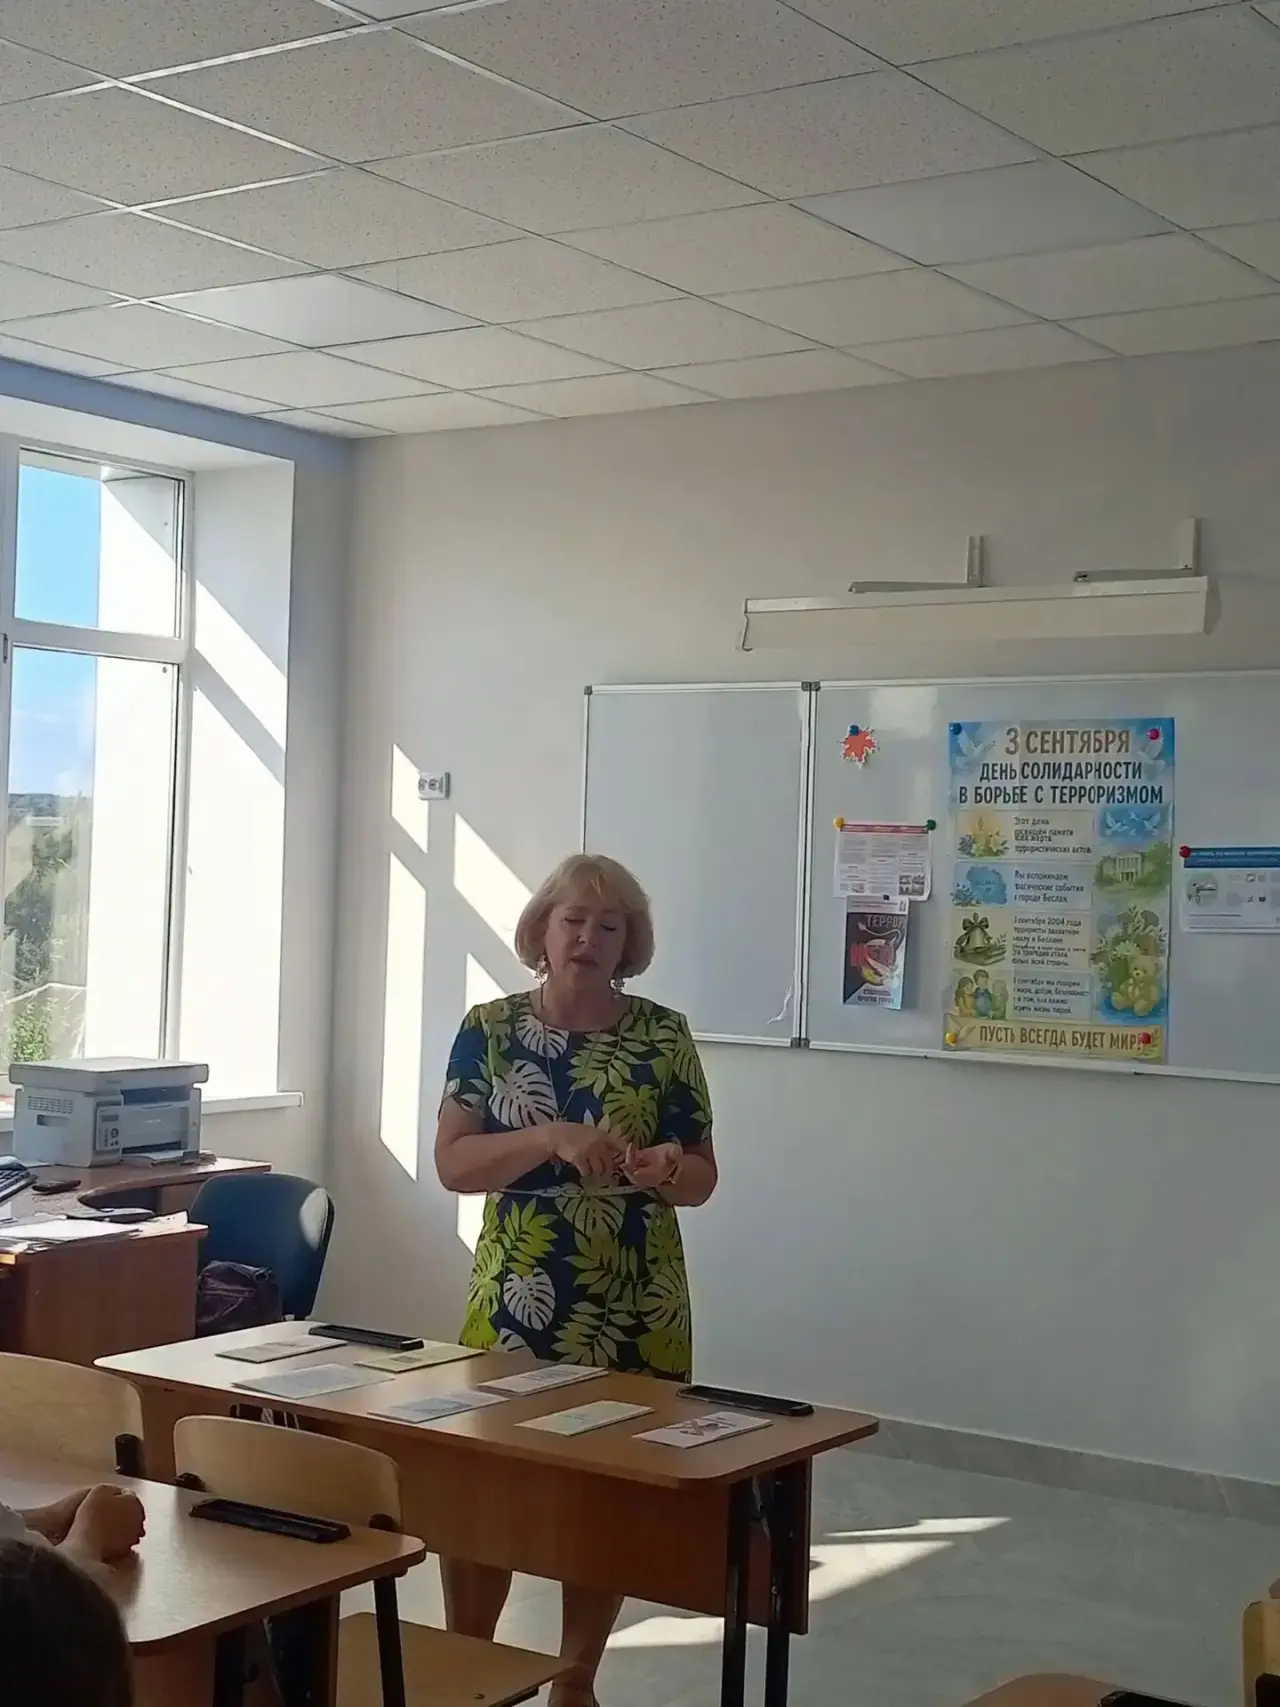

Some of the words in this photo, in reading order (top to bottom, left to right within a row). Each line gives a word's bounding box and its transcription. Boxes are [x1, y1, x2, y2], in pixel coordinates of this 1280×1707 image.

[1005, 727, 1020, 755] 3
[1026, 729, 1131, 754] СЕНТЯБРЯ
[980, 763, 1017, 782] ДЕНЬ
[1021, 761, 1142, 782] СОЛИДАРНОСТИ
[959, 786, 968, 804] В
[974, 786, 1027, 804] БОРЬБЕ
[1035, 785, 1044, 803] С
[1050, 785, 1163, 804] ТЕРРОРИЗМОМ
[980, 1025, 1016, 1044] ПУСТЬ
[1020, 1027, 1066, 1047] ВСЕГДА
[1071, 1030, 1106, 1049] БУДЕТ
